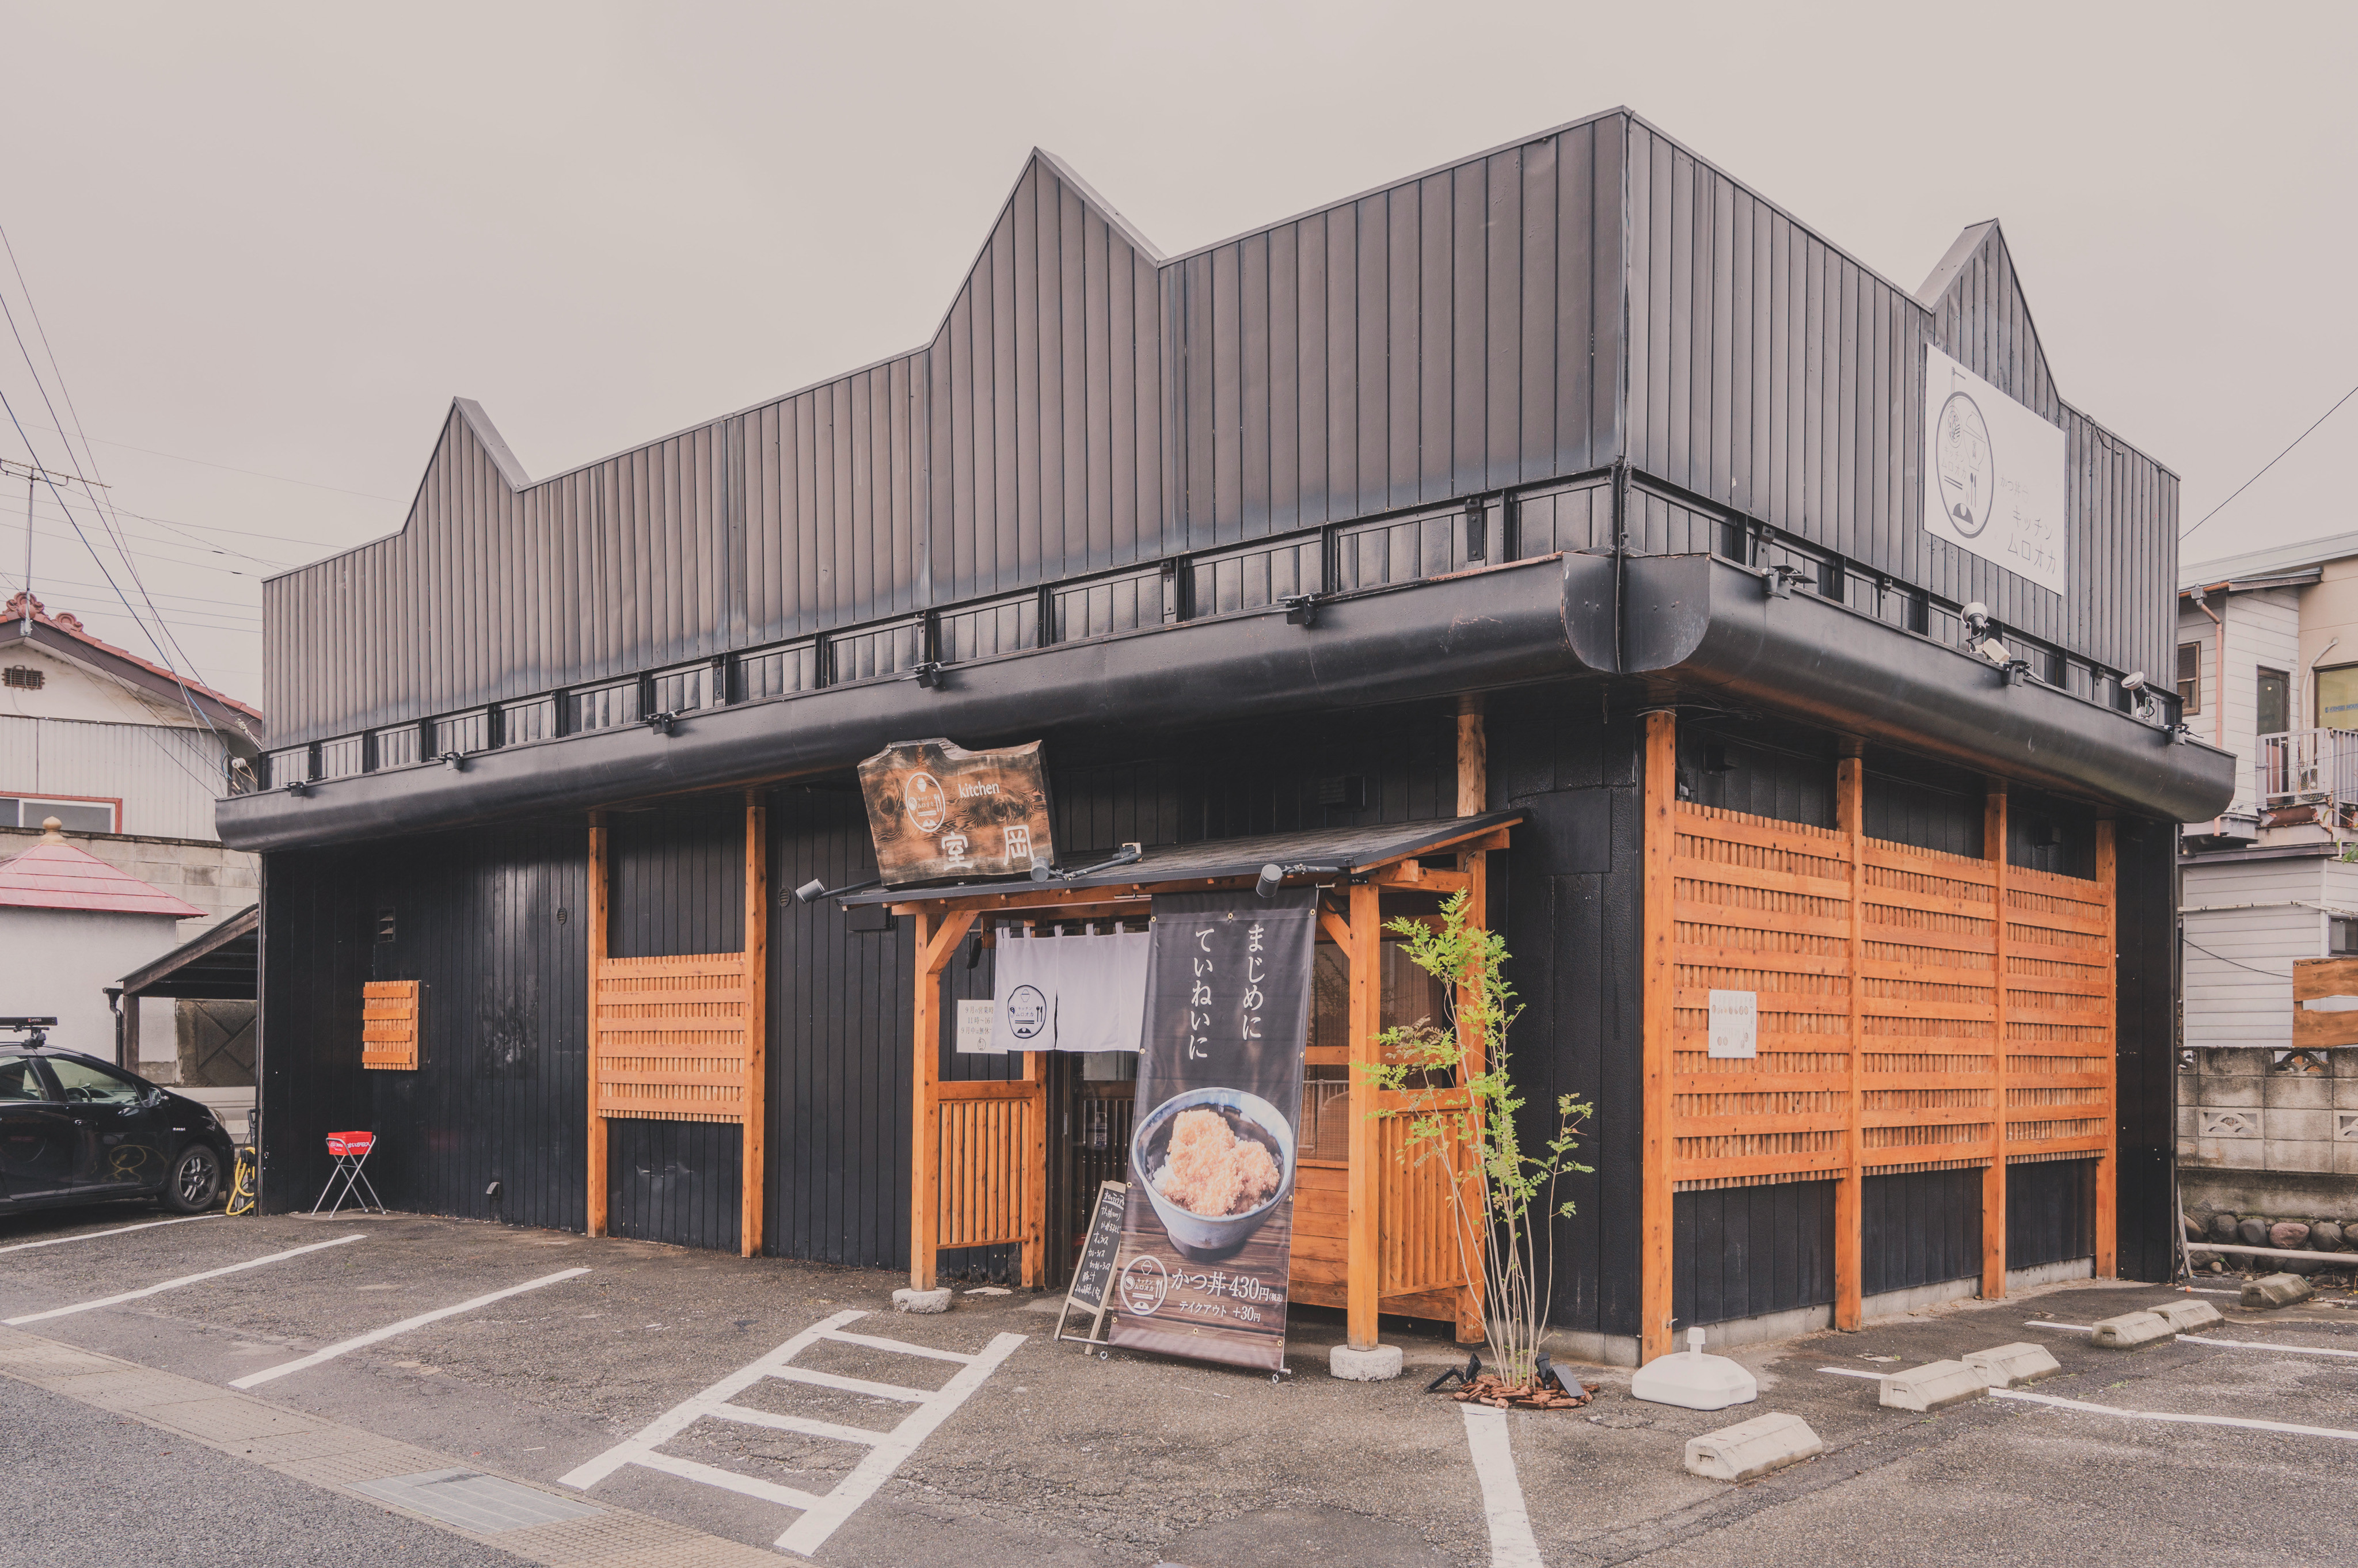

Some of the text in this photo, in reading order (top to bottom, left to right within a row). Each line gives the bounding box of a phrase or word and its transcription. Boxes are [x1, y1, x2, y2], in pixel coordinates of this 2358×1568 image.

[1941, 458, 1967, 479] ムロオカ
[2013, 505, 2052, 540] キッチン
[2007, 532, 2056, 574] ムロオカ
[958, 781, 1000, 798] kitchen
[917, 800, 934, 809] ムロオカ
[1243, 924, 1265, 1041] まじめに
[1189, 928, 1215, 1060] ていねいに
[1134, 1284, 1154, 1292] ムロオカ
[1179, 1301, 1261, 1323] テイクアウト +30円
